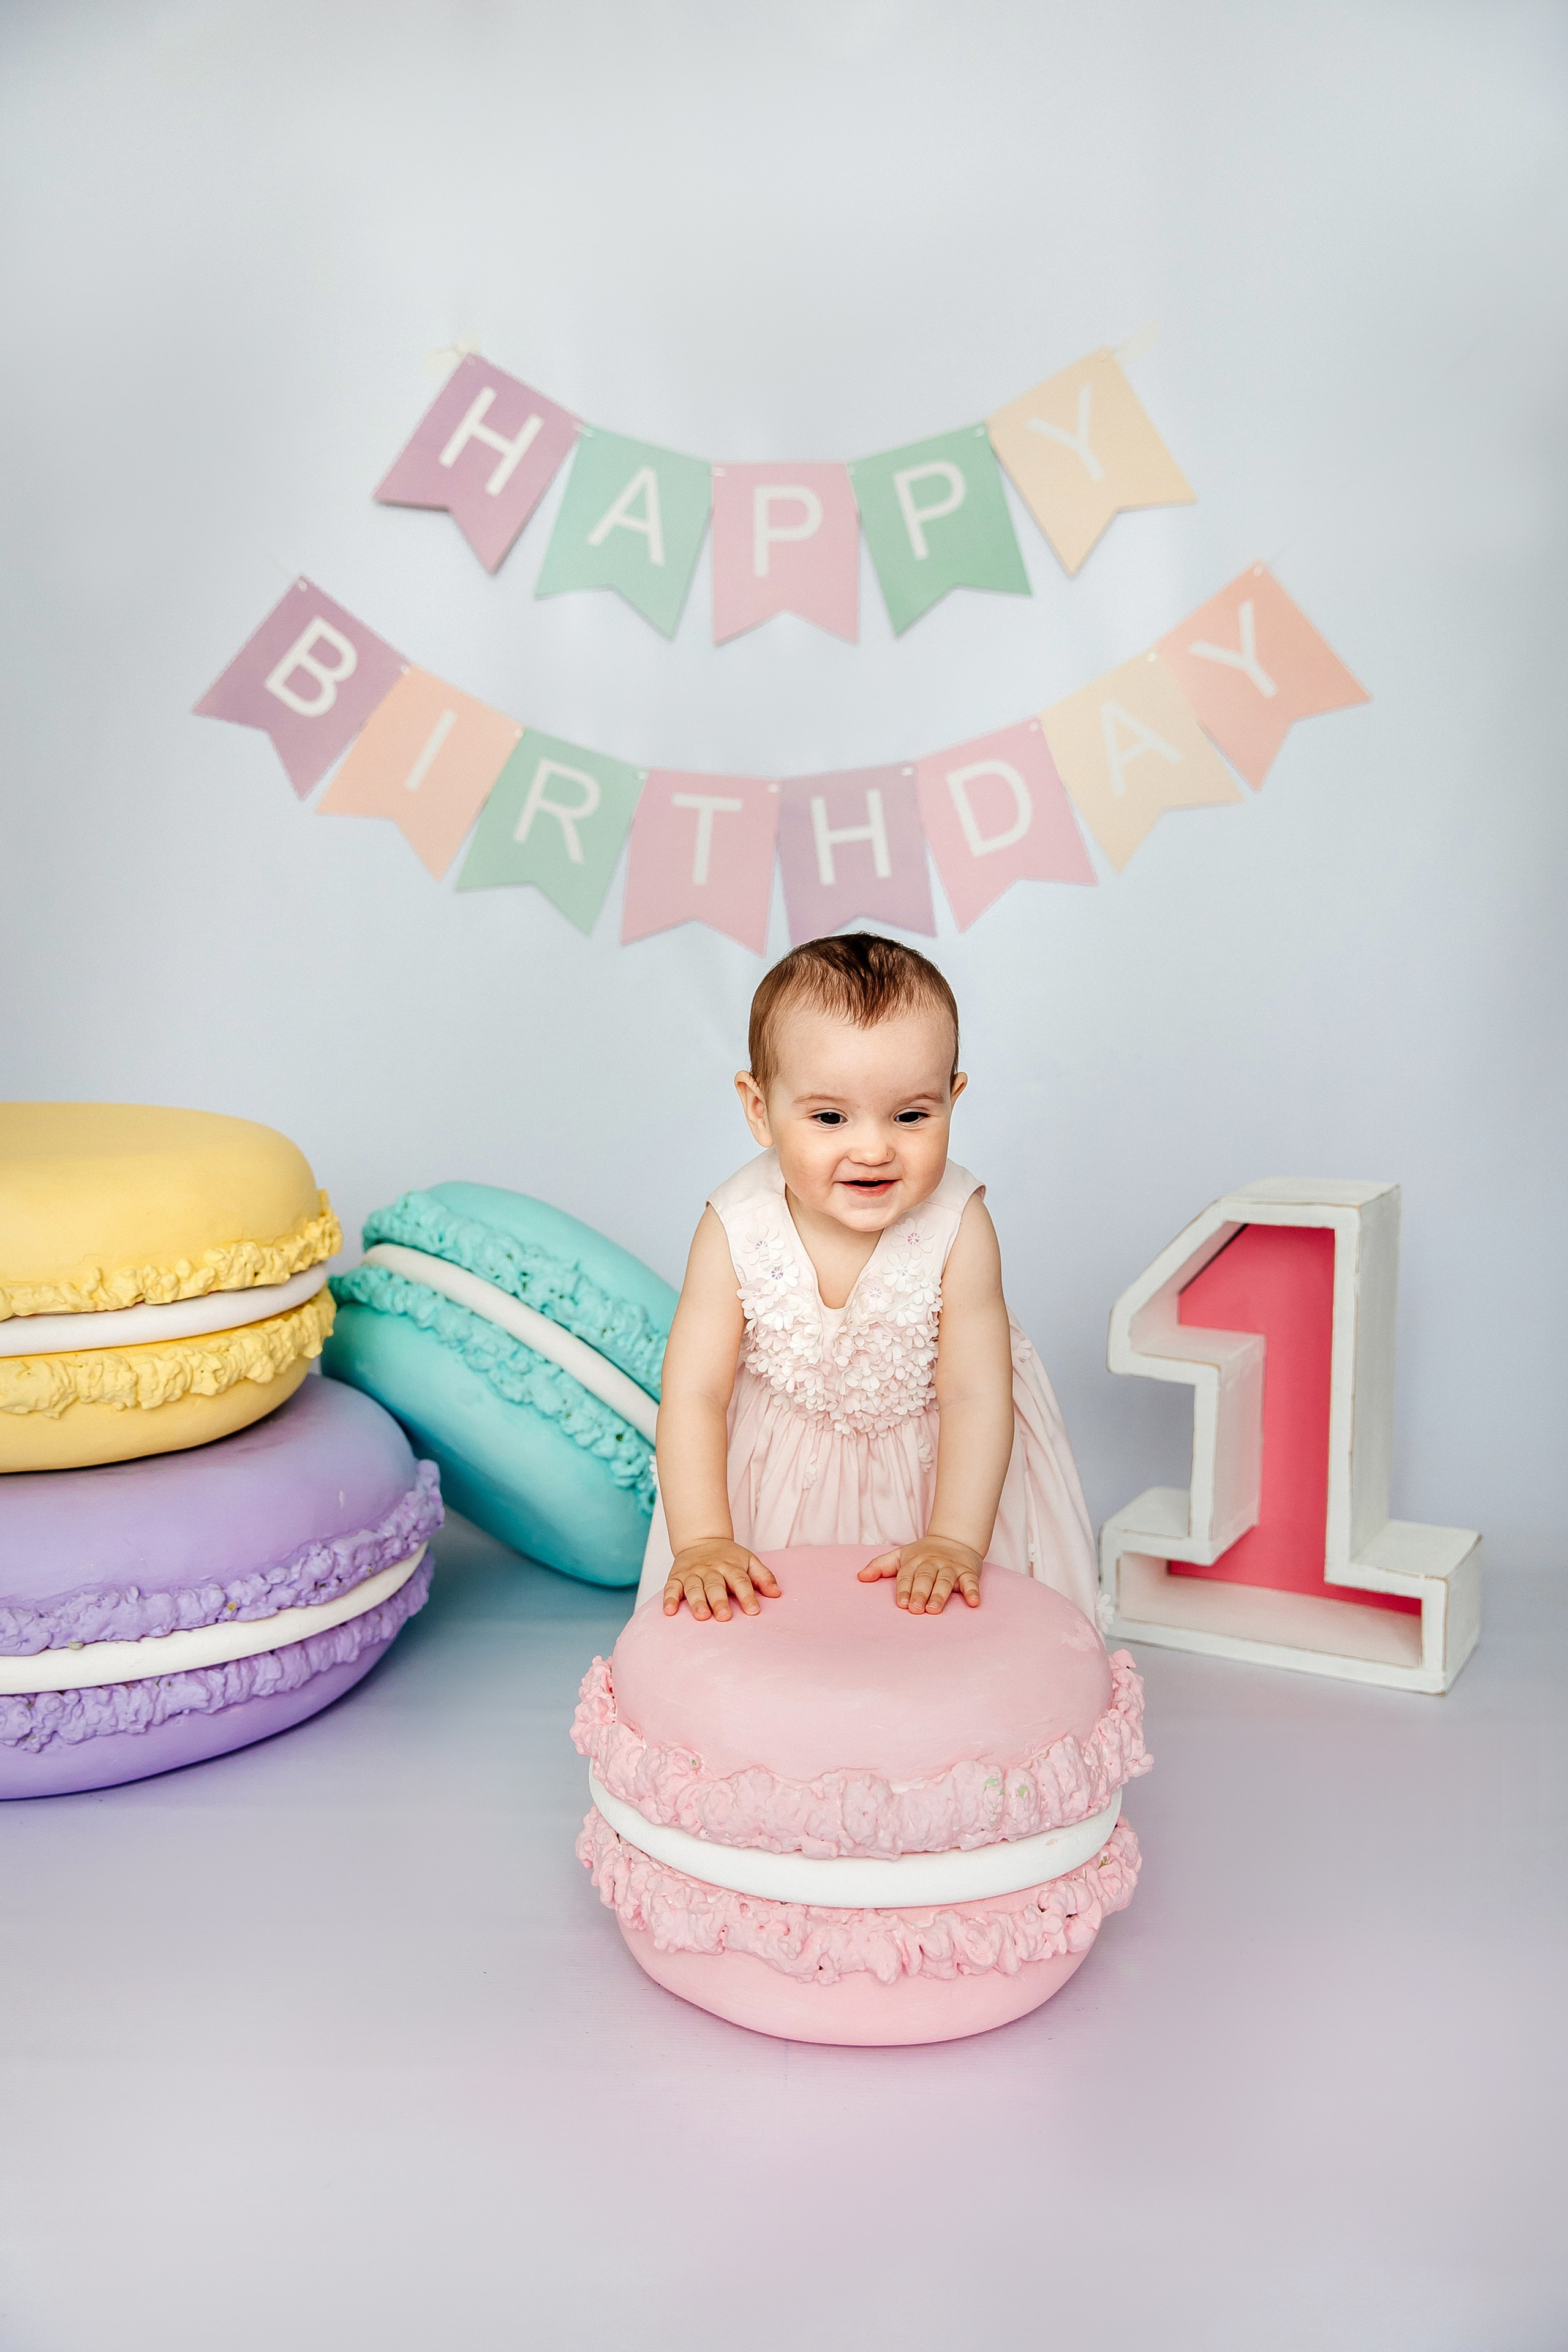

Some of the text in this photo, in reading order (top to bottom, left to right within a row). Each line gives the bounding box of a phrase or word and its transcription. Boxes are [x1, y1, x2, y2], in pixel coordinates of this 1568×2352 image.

[437, 382, 1104, 578] HAPPY
[264, 598, 1278, 886] BIRTHDAY
[1099, 1177, 1483, 1695] 1
